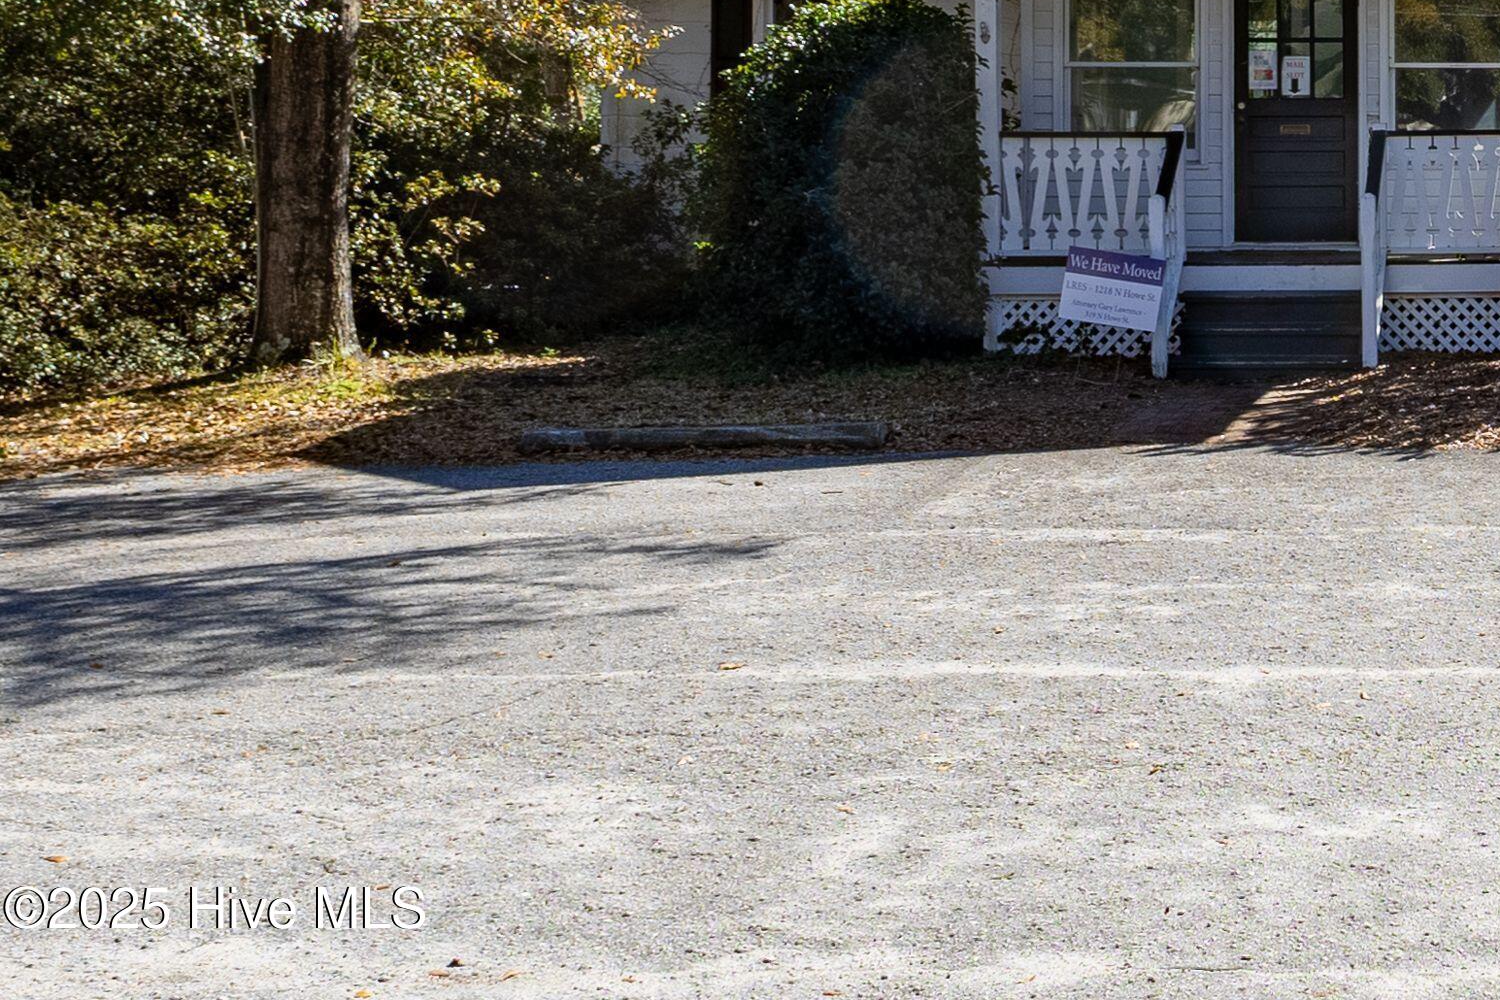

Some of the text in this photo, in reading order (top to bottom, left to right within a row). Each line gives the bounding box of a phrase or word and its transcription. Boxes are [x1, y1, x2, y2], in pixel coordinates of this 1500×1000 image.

[1070, 254, 1162, 281] We Have Moved
[1066, 281, 1087, 292] LRES
[1114, 288, 1122, 297] N
